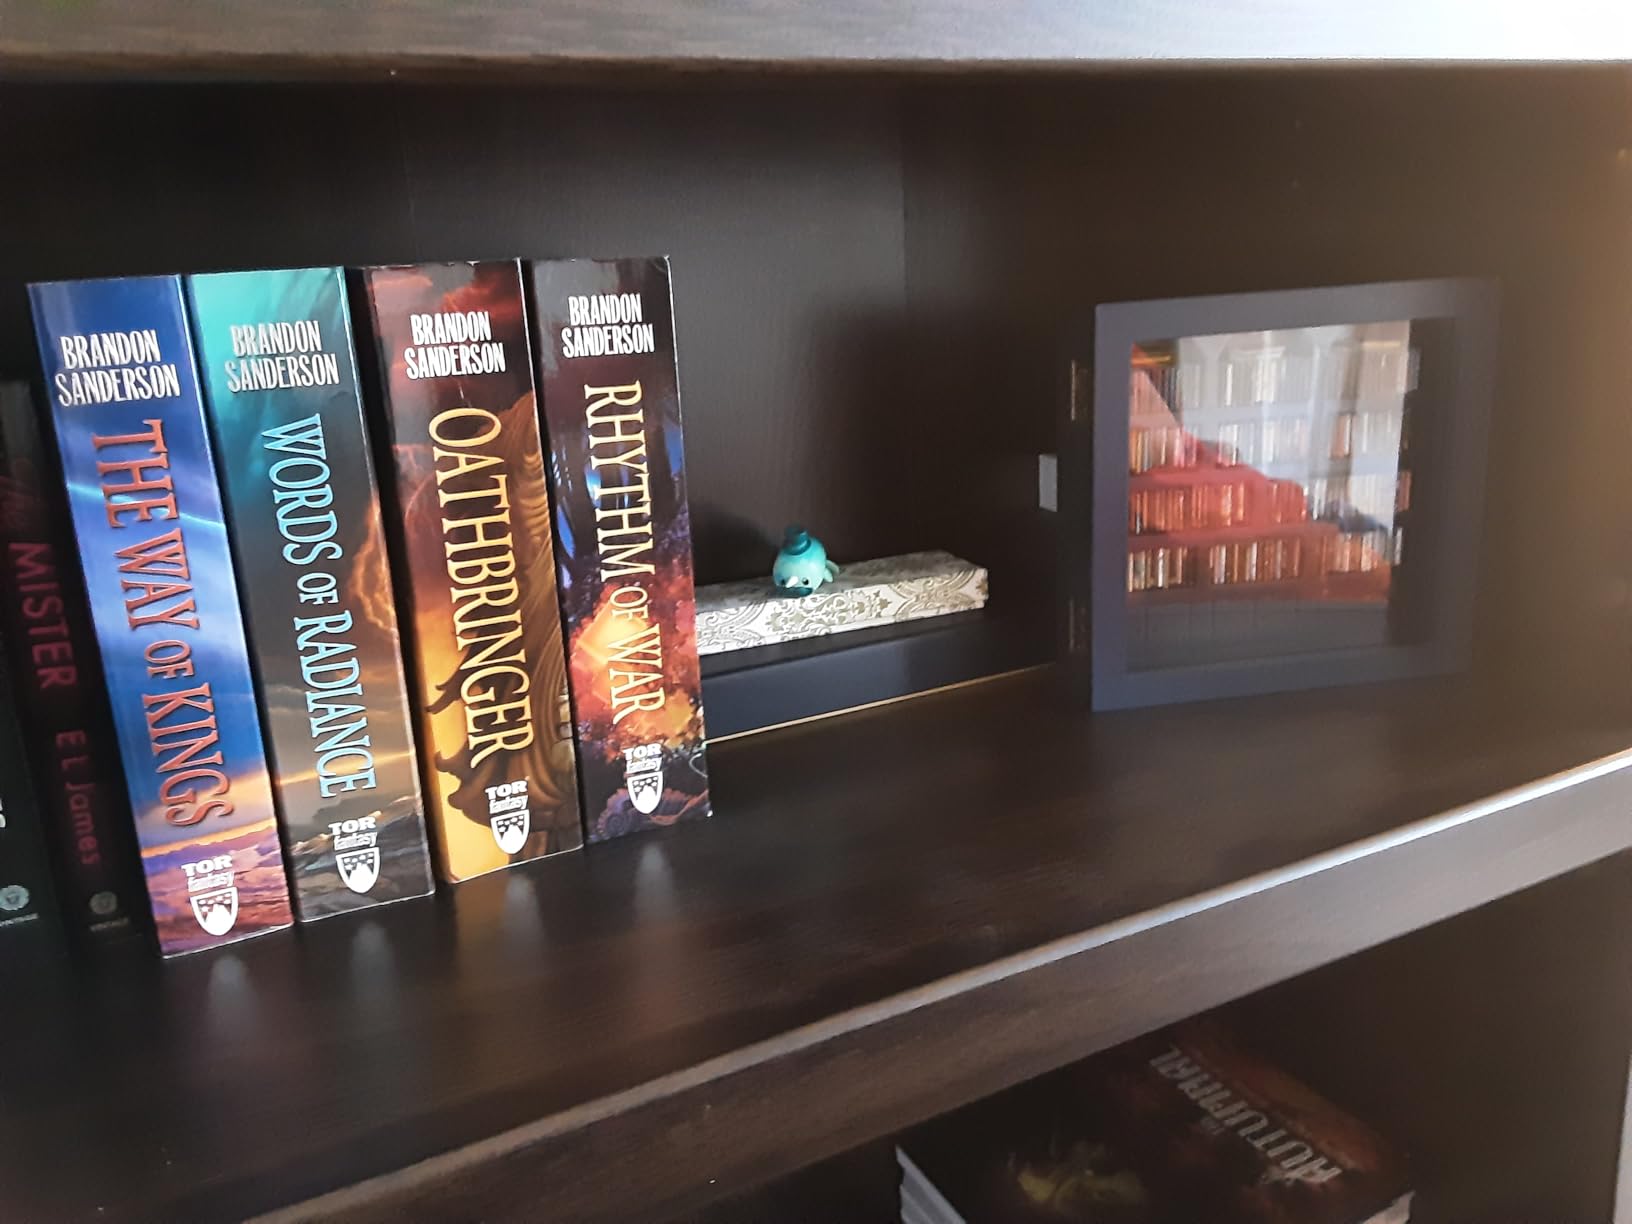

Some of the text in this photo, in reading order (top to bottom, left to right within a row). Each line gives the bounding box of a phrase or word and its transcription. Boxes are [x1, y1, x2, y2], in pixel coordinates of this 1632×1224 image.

[410, 311, 492, 346] BRANDON
[567, 294, 643, 326] BRANDON
[59, 329, 161, 370] BRANDON
[229, 320, 322, 358] BRANDON
[561, 323, 654, 358] SANDERSON
[224, 353, 340, 392] SANDERSON
[404, 343, 506, 379] SANDERSON
[55, 363, 181, 407] SANDERSON
[584, 380, 666, 725] RHYTHM OF WAR
[261, 413, 377, 799] WORDS OF RADIANCE
[428, 407, 534, 769] OATHBRINGER
[8, 541, 78, 690] MISTER
[91, 418, 235, 827] THE WAY OF KINGS
[623, 743, 662, 761] TOR
[55, 729, 101, 866] E L James
[484, 779, 528, 798] TOR
[328, 816, 377, 836] TOR
[181, 854, 233, 878] TOR
